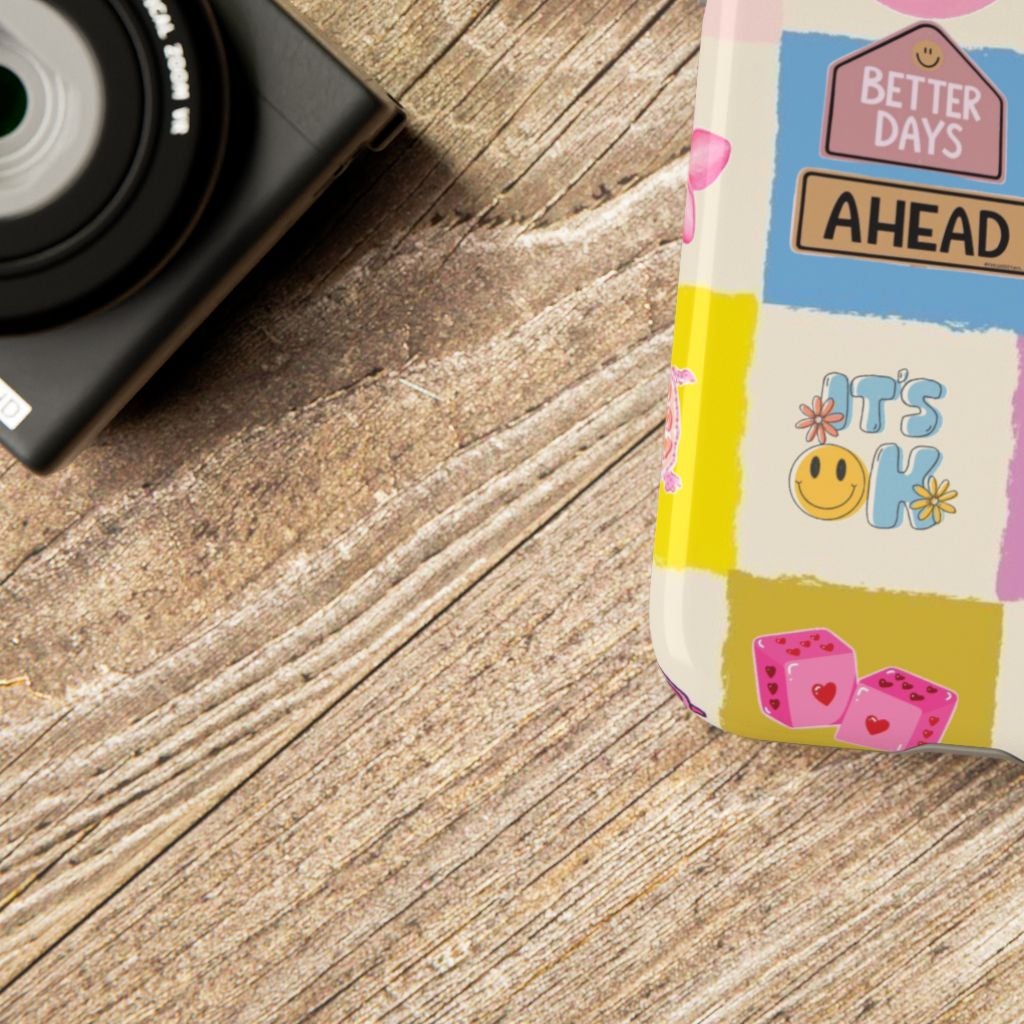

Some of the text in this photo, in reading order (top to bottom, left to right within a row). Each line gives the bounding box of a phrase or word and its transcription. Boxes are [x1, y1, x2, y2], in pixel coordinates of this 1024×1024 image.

[163, 42, 190, 100] ZOOM
[860, 66, 981, 121] BETTER
[874, 110, 963, 159] DAYS
[823, 191, 1010, 258] AHEAD
[821, 368, 947, 437] IT'S
